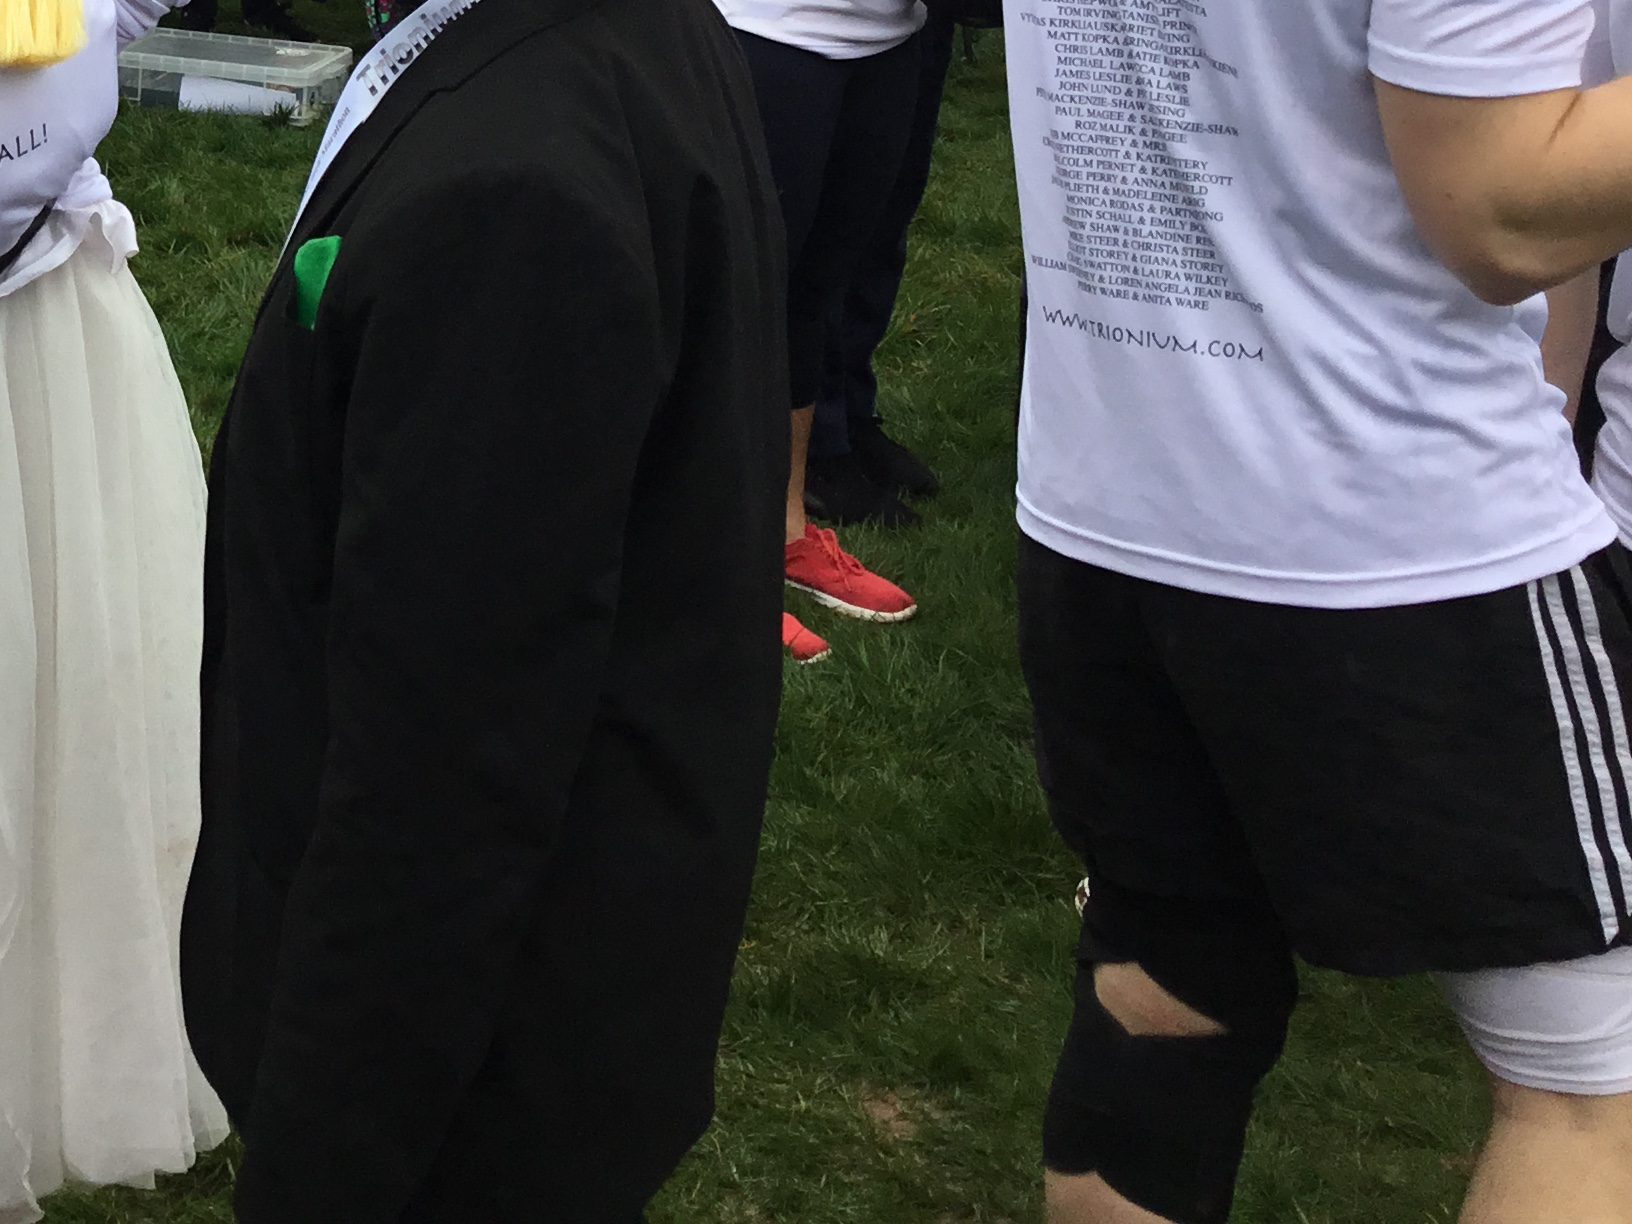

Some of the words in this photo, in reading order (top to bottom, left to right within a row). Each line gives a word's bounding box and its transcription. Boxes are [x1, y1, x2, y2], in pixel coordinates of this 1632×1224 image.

[1057, 5, 1081, 17] TOM
[1047, 30, 1080, 42] MATT
[1082, 33, 1120, 46] KOPKA
[1055, 43, 1088, 55] CHRIS
[1089, 46, 1124, 58] LAMB
[1057, 56, 1106, 69] MICHAEL
[1055, 68, 1091, 80] JAMES
[1092, 71, 1133, 84] LESLIE
[1058, 81, 1088, 92] JOHN
[1091, 84, 1122, 96] LUND
[1055, 105, 1084, 117] PAUL
[1087, 108, 1124, 121] MAGEE
[1075, 120, 1098, 131] ROZ
[1099, 122, 1136, 135] MALIK
[1061, 131, 1127, 147] MCCAFFREY
[1097, 160, 1136, 173] PERNET
[1086, 172, 1118, 184] PERRY
[1131, 177, 1166, 190] ANNA
[1066, 194, 1107, 208] MONICA
[1109, 199, 1145, 212] RODAS
[1112, 187, 1179, 204] MADELEINE
[1095, 210, 1135, 224] SCHALL
[1150, 217, 1187, 231] EMILY
[1089, 222, 1120, 234] SHAW
[1132, 227, 1193, 244] BLANDINE
[1087, 235, 1120, 247] STEER
[1130, 240, 1179, 255] CHRISTA
[1182, 247, 1216, 260] STEER
[1088, 247, 1130, 261] STOREY
[1140, 254, 1178, 268] GIANA
[1180, 259, 1224, 274] STOREY
[1031, 255, 1067, 271] WILLIAM
[1108, 275, 1143, 289] LOREN
[1144, 281, 1190, 296] ANGELA
[1193, 287, 1222, 299] JEAN
[1083, 259, 1131, 274] SWATTON
[1141, 267, 1181, 282] LAURA
[1184, 272, 1229, 287] WILKEY
[1099, 286, 1129, 300] WARE
[1141, 293, 1172, 307] ANITA
[1175, 297, 1210, 311] WARE
